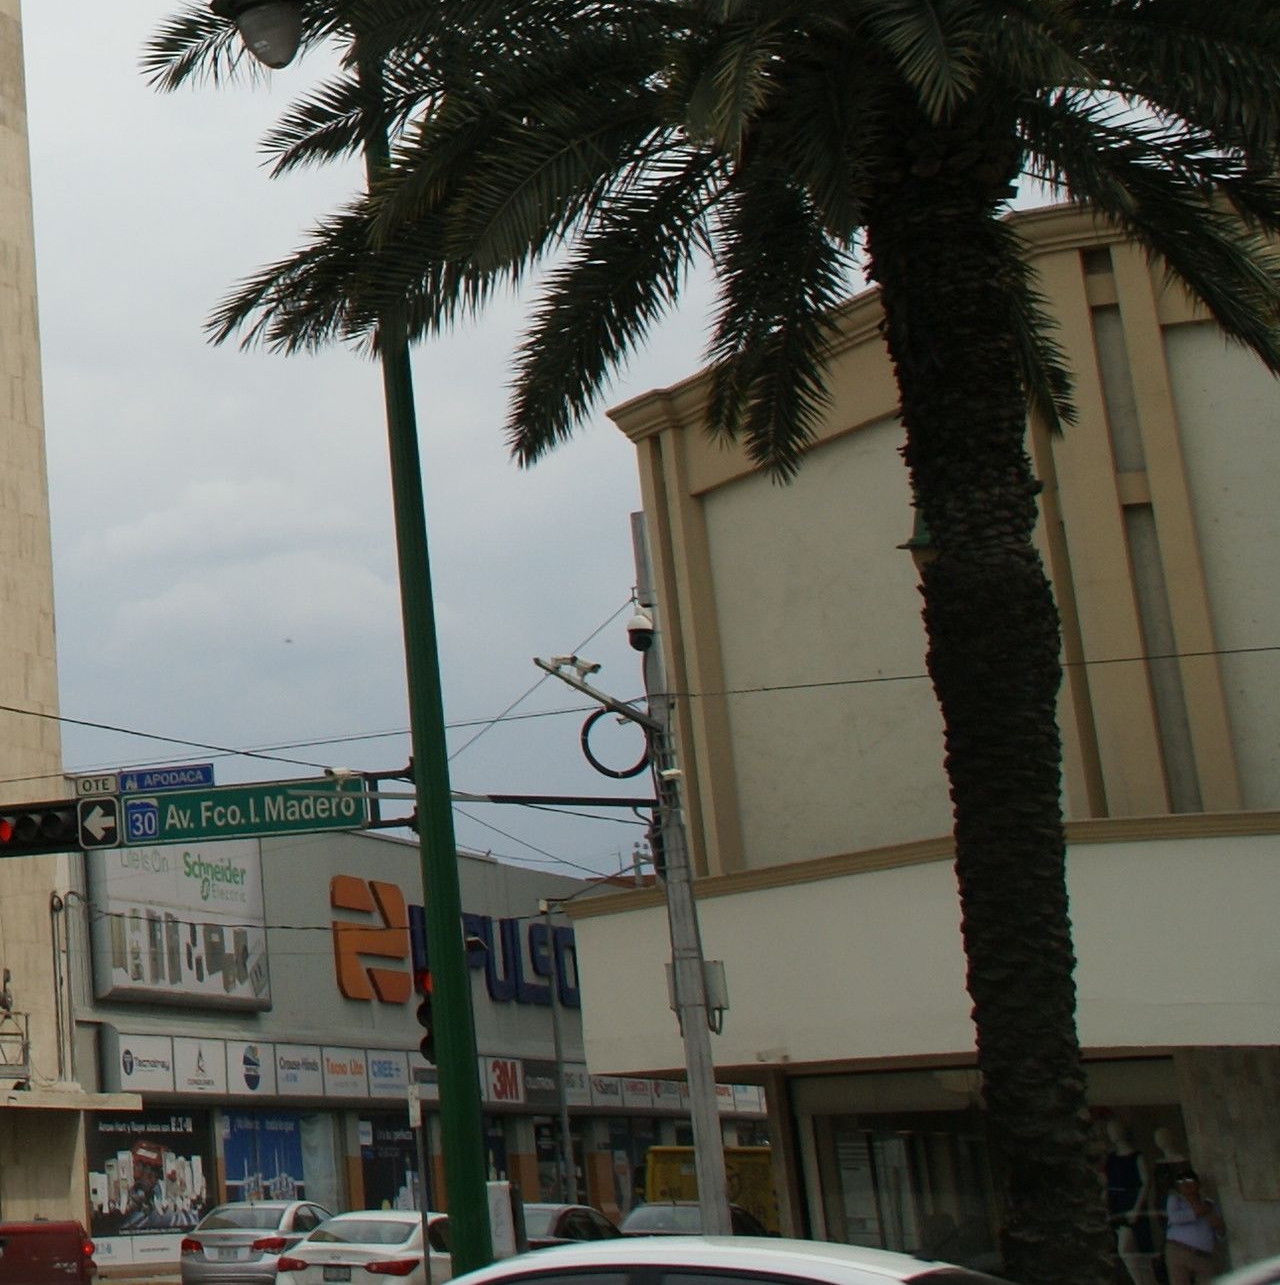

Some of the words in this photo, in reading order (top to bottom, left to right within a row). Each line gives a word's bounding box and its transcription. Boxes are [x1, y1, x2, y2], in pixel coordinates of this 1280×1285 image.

[82, 781, 110, 793] OTE
[143, 770, 204, 787] APODACA
[132, 813, 156, 836] 30
[164, 804, 194, 830] Av.
[201, 800, 246, 829] Fco.
[249, 798, 260, 823] I.
[264, 793, 355, 821] Madero
[183, 851, 246, 885] Schneider
[492, 1061, 519, 1100] 3M
